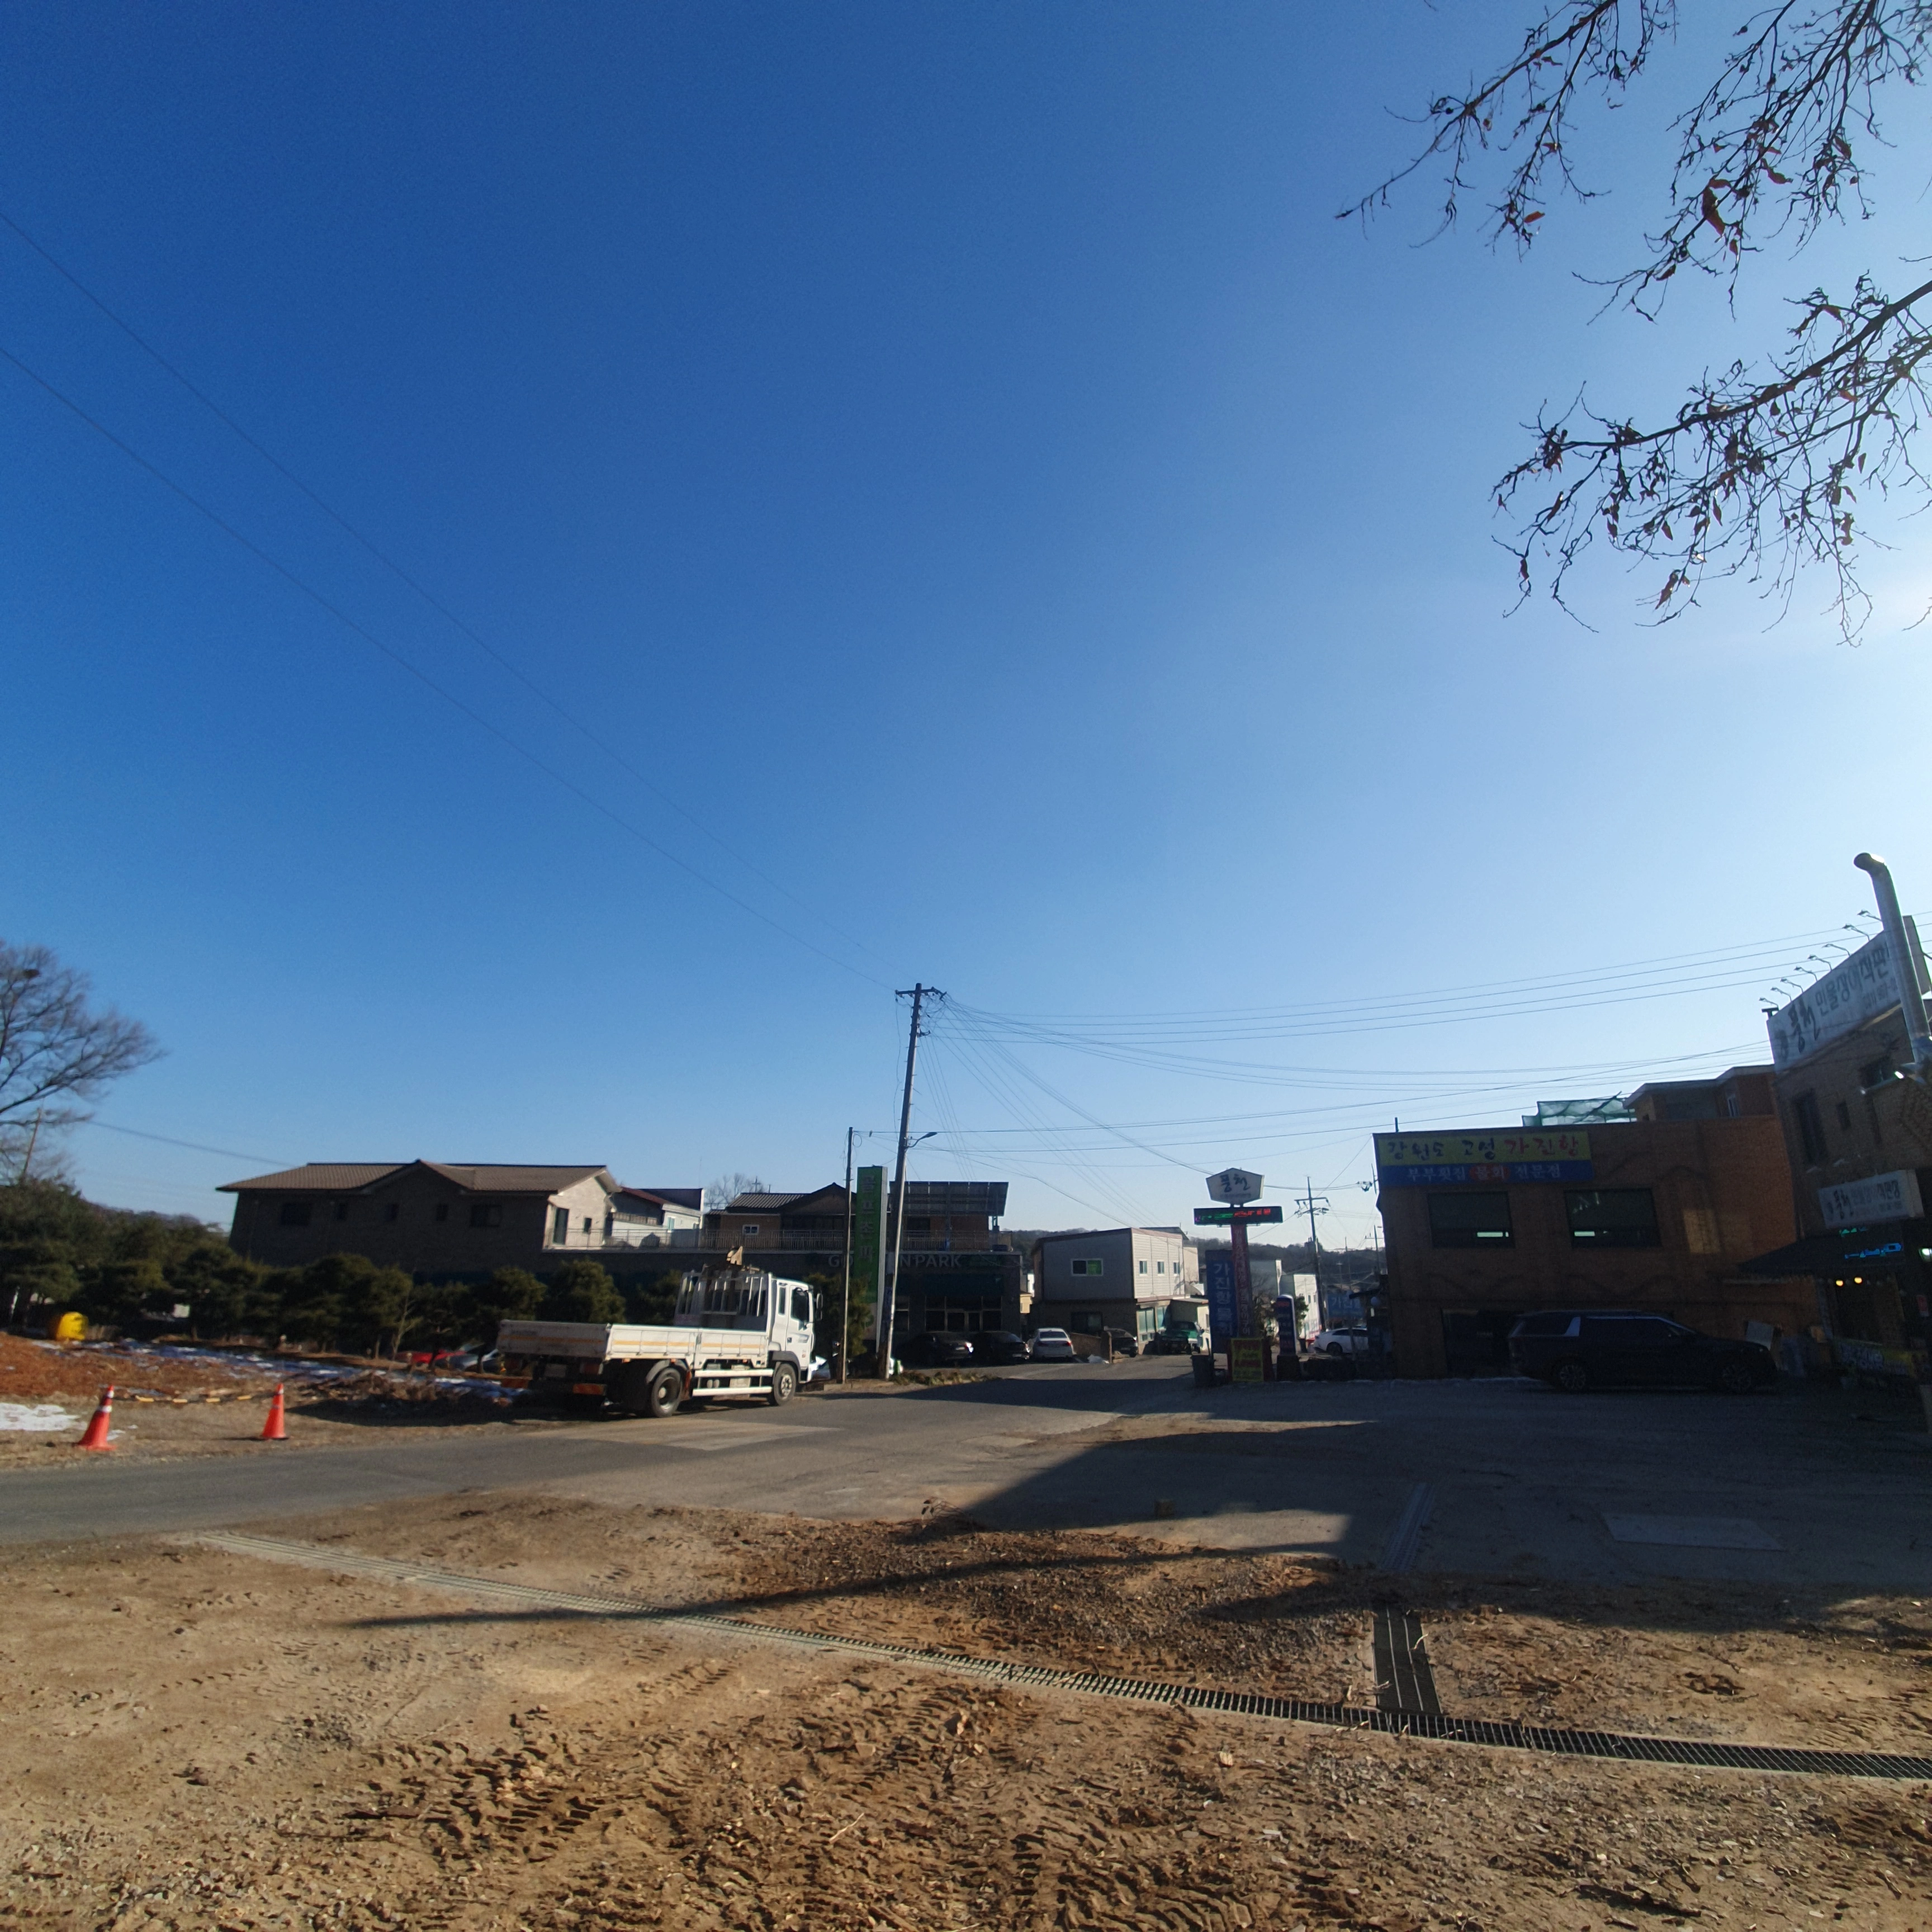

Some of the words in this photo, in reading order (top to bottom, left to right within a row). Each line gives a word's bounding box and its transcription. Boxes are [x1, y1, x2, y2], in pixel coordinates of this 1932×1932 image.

[1387, 1140, 1445, 1161] 강원도
[1504, 1134, 1579, 1157] 가진항
[1407, 1166, 1466, 1182] 부부횟집
[1477, 1163, 1505, 1181] 물회
[1516, 1163, 1562, 1180] 전문점
[1219, 1173, 1251, 1192] 풍천
[915, 1254, 961, 1268] PARK
